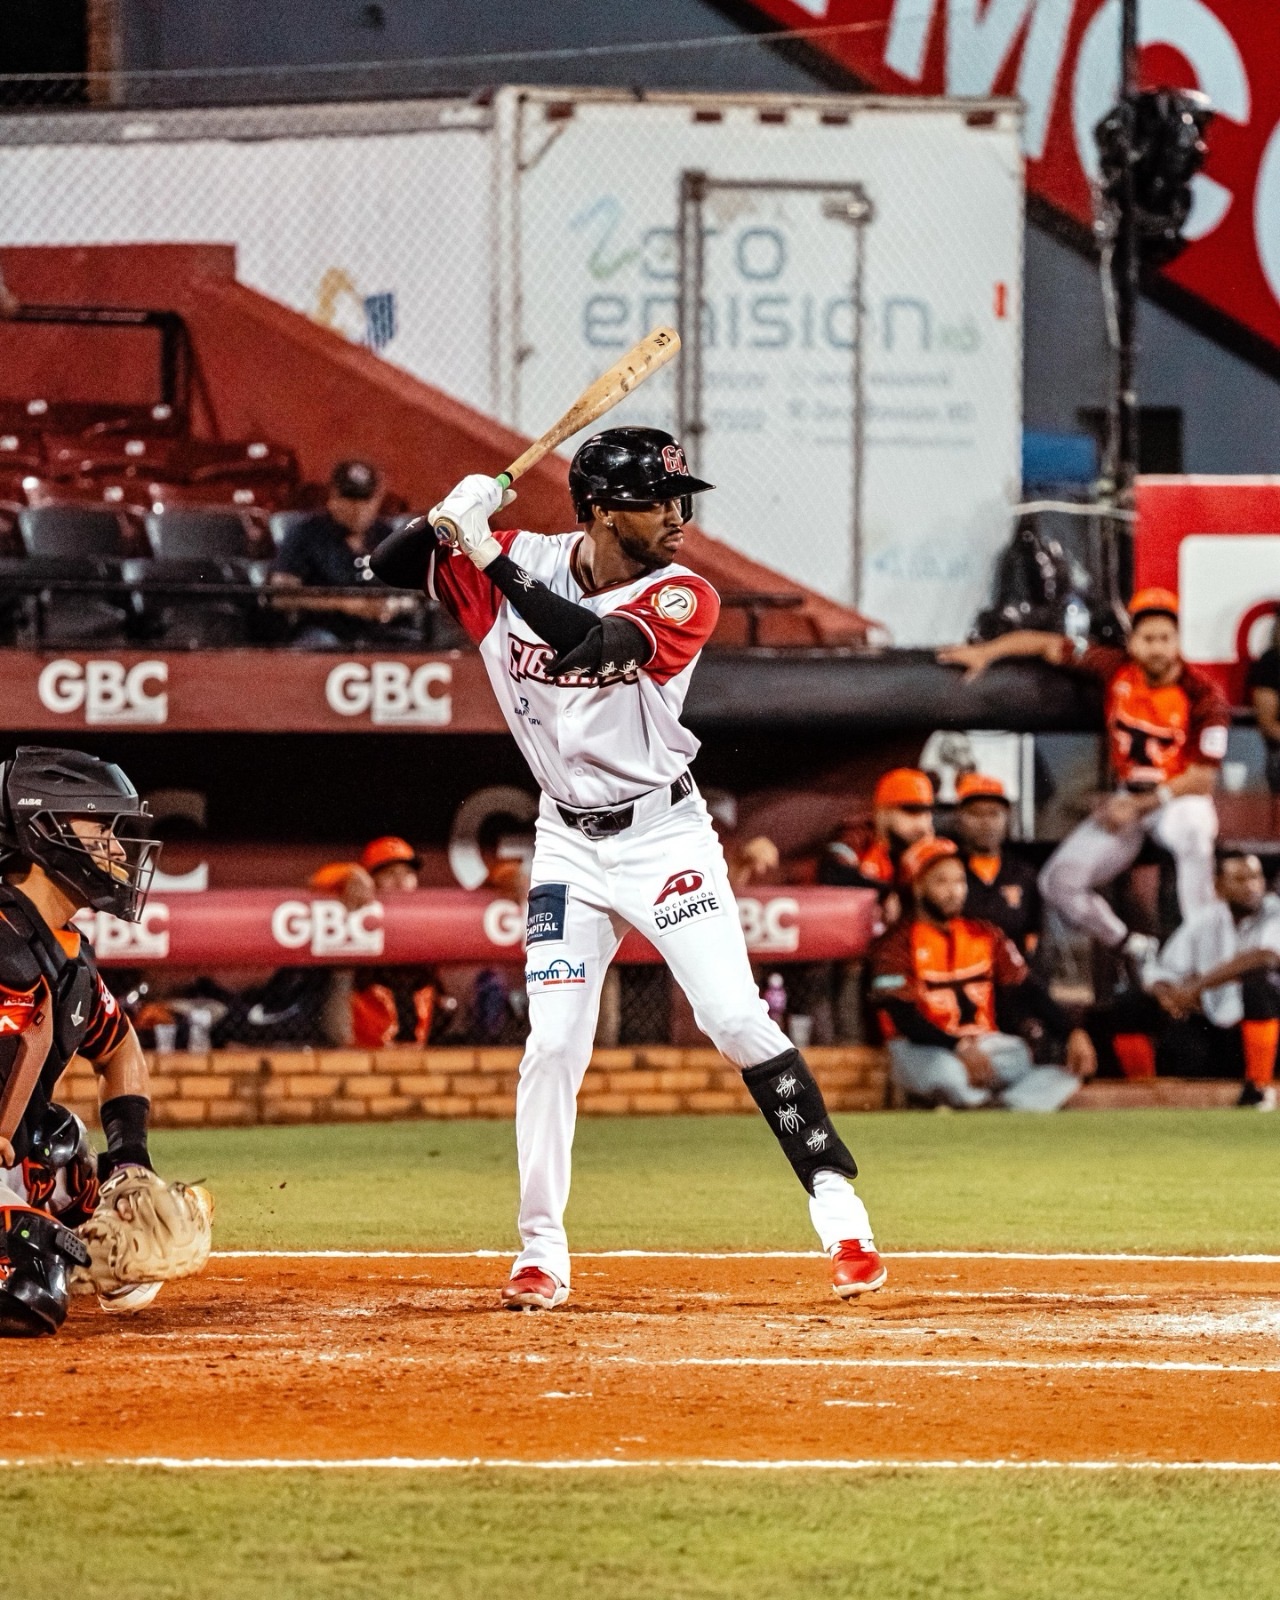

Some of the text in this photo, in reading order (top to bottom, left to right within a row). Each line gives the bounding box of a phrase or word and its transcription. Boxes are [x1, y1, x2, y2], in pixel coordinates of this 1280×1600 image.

[38, 659, 168, 725] GBC
[325, 661, 451, 726] GBC
[271, 899, 385, 957] GBC
[653, 891, 714, 917] ASOCIACIÓN
[655, 897, 720, 930] DUARTE
[738, 897, 801, 953] BC
